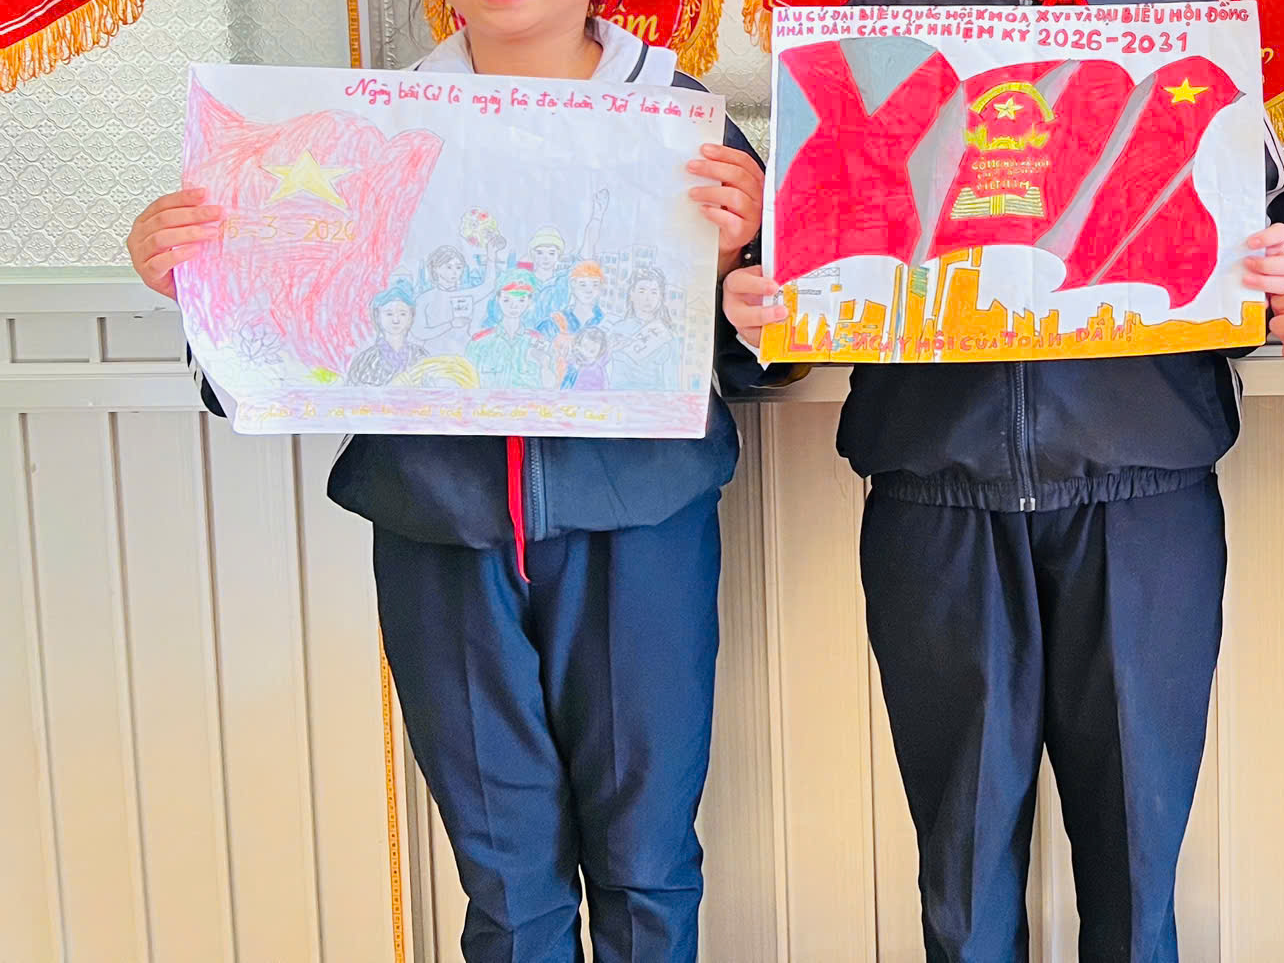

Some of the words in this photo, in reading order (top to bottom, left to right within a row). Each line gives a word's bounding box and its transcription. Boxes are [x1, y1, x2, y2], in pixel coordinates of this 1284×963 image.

[1075, 7, 1093, 21] VÀ
[1169, 4, 1202, 26] HỘI
[857, 20, 888, 36] CÁC
